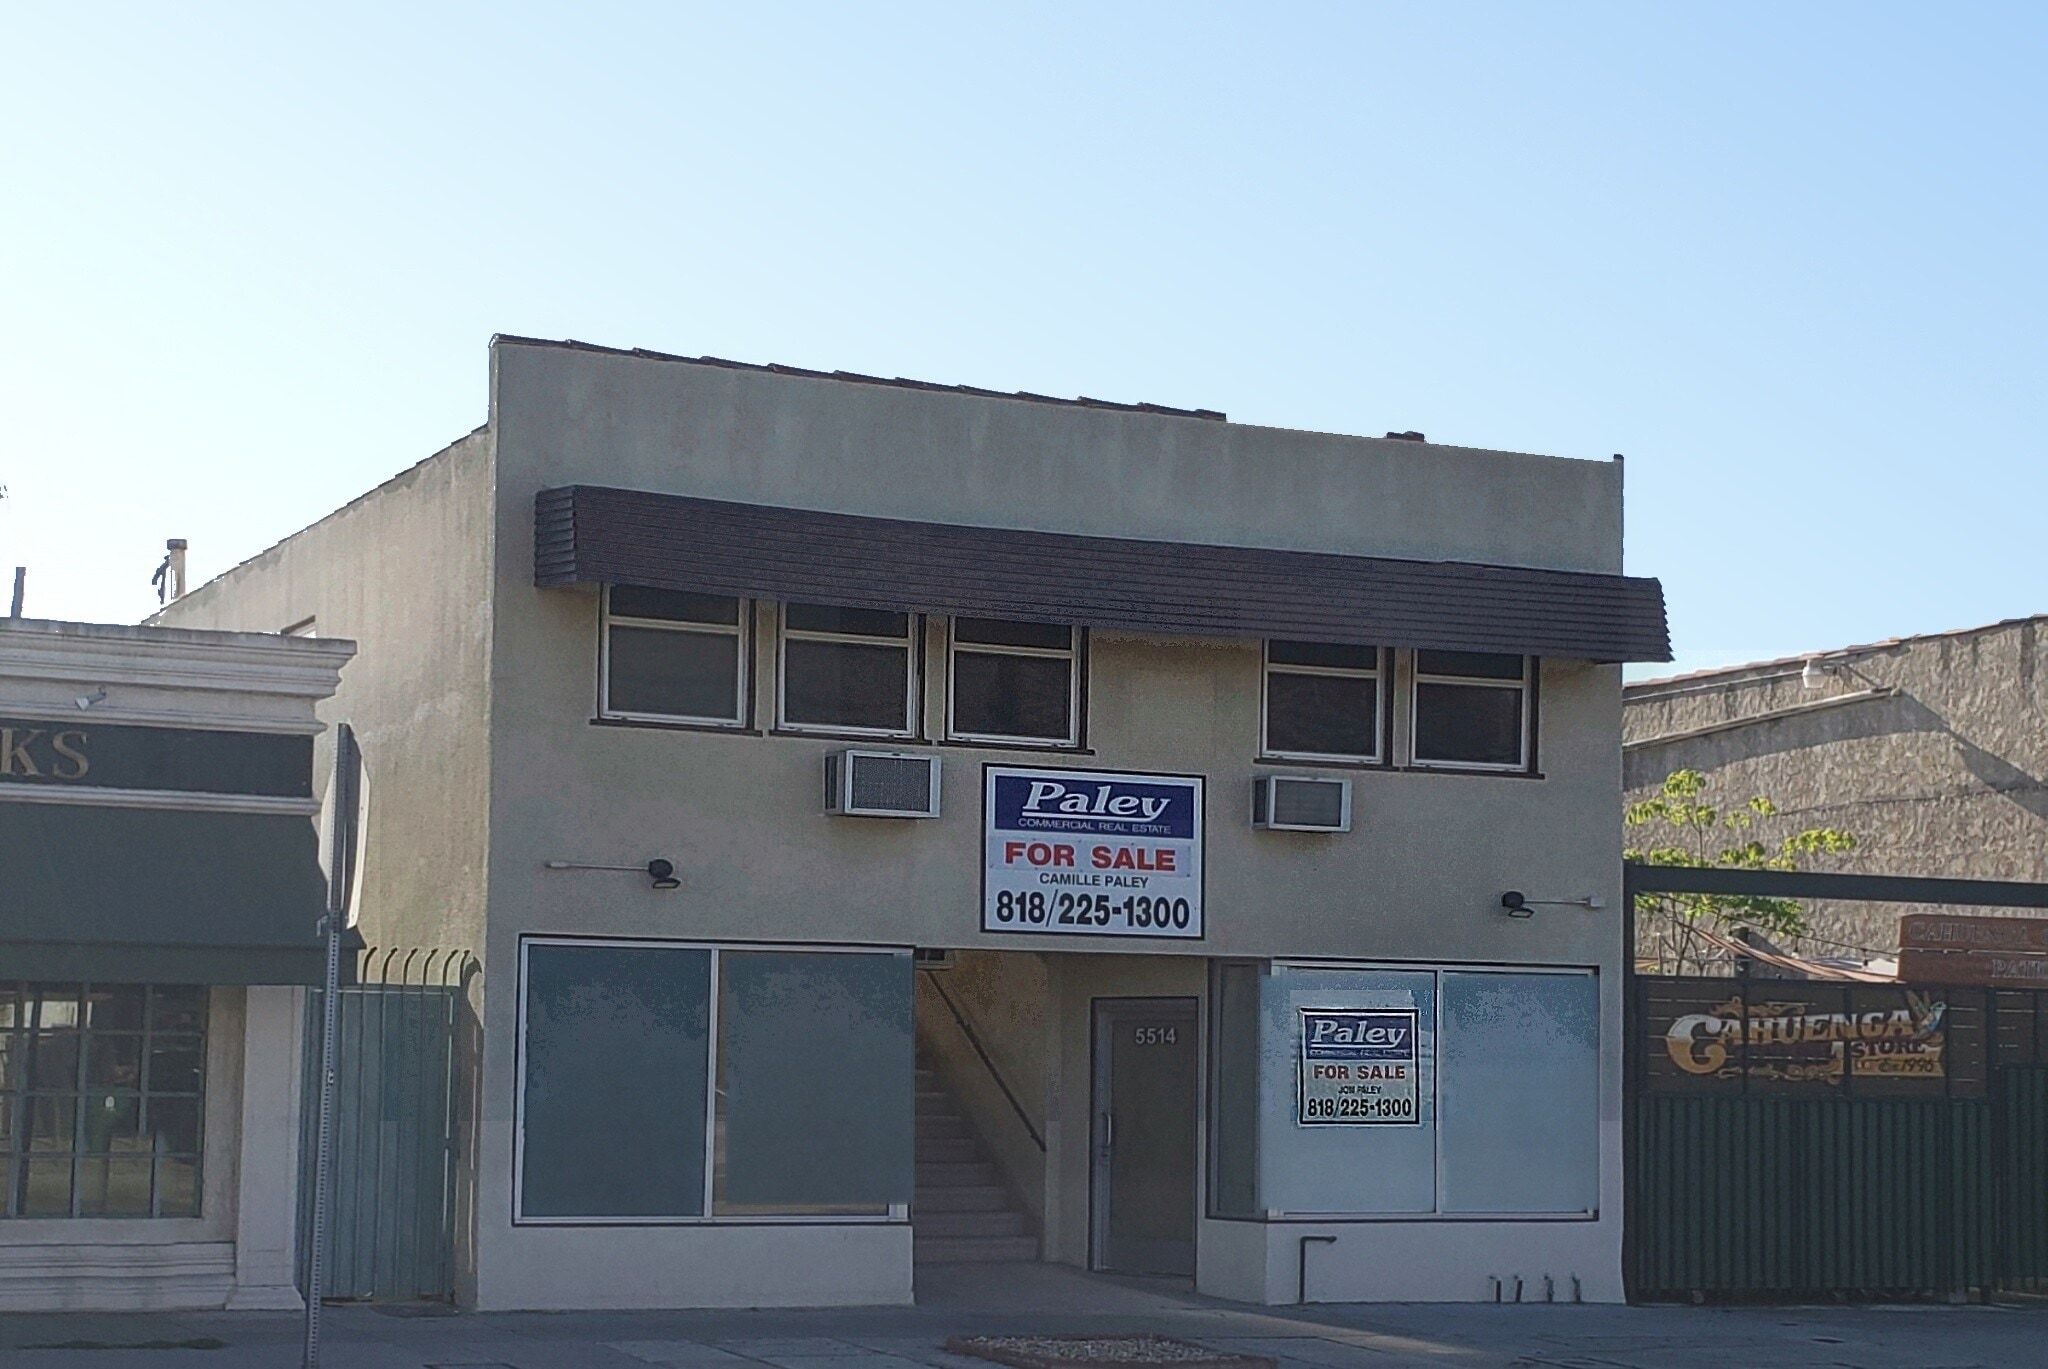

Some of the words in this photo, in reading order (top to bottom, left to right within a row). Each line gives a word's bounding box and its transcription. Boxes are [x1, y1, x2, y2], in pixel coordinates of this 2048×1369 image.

[1021, 781, 1171, 822] Paley
[1018, 817, 1095, 831] COMMERCIAL
[1099, 822, 1129, 833] REAL
[1132, 825, 1172, 835] ESTATE
[1005, 841, 1075, 867] FOR
[1091, 846, 1176, 871] SALE
[1039, 873, 1101, 887] CAMILLE
[1104, 875, 1149, 889] PALEY
[996, 889, 1190, 929] 818/225-1300
[1135, 1027, 1177, 1044] 5514
[1310, 1019, 1407, 1048] Paley
[1666, 1008, 1915, 1075] CAHUENGA
[1850, 1040, 1926, 1058] STORE
[1313, 1065, 1350, 1080] FOR
[1357, 1065, 1406, 1080] SALE
[1900, 1057, 1935, 1074] 1996
[1307, 1098, 1412, 1118] 818/225-1300
